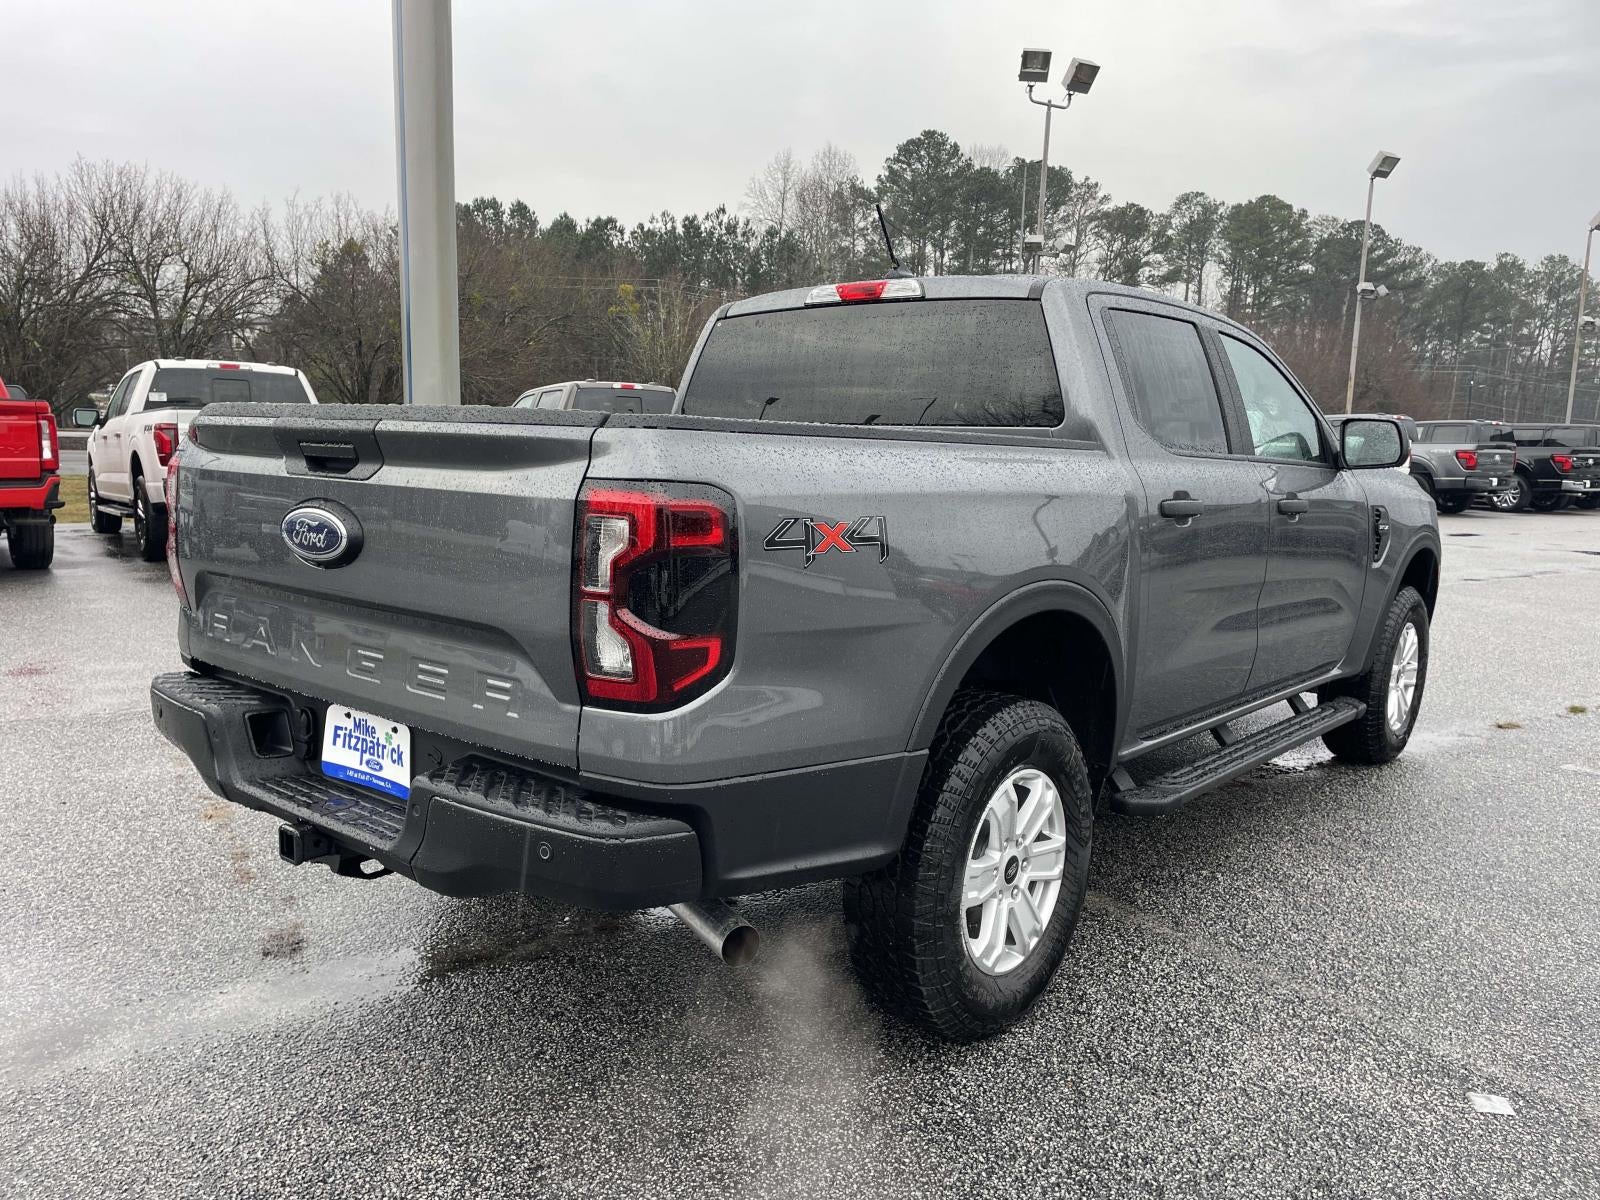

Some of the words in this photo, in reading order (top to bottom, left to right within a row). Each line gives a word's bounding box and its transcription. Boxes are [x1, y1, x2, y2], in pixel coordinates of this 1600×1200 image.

[292, 517, 328, 548] Ford
[205, 601, 525, 718] RANGER
[353, 716, 377, 739] Mike
[332, 724, 404, 768] Fitzpatrick
[367, 759, 381, 771] Ford
